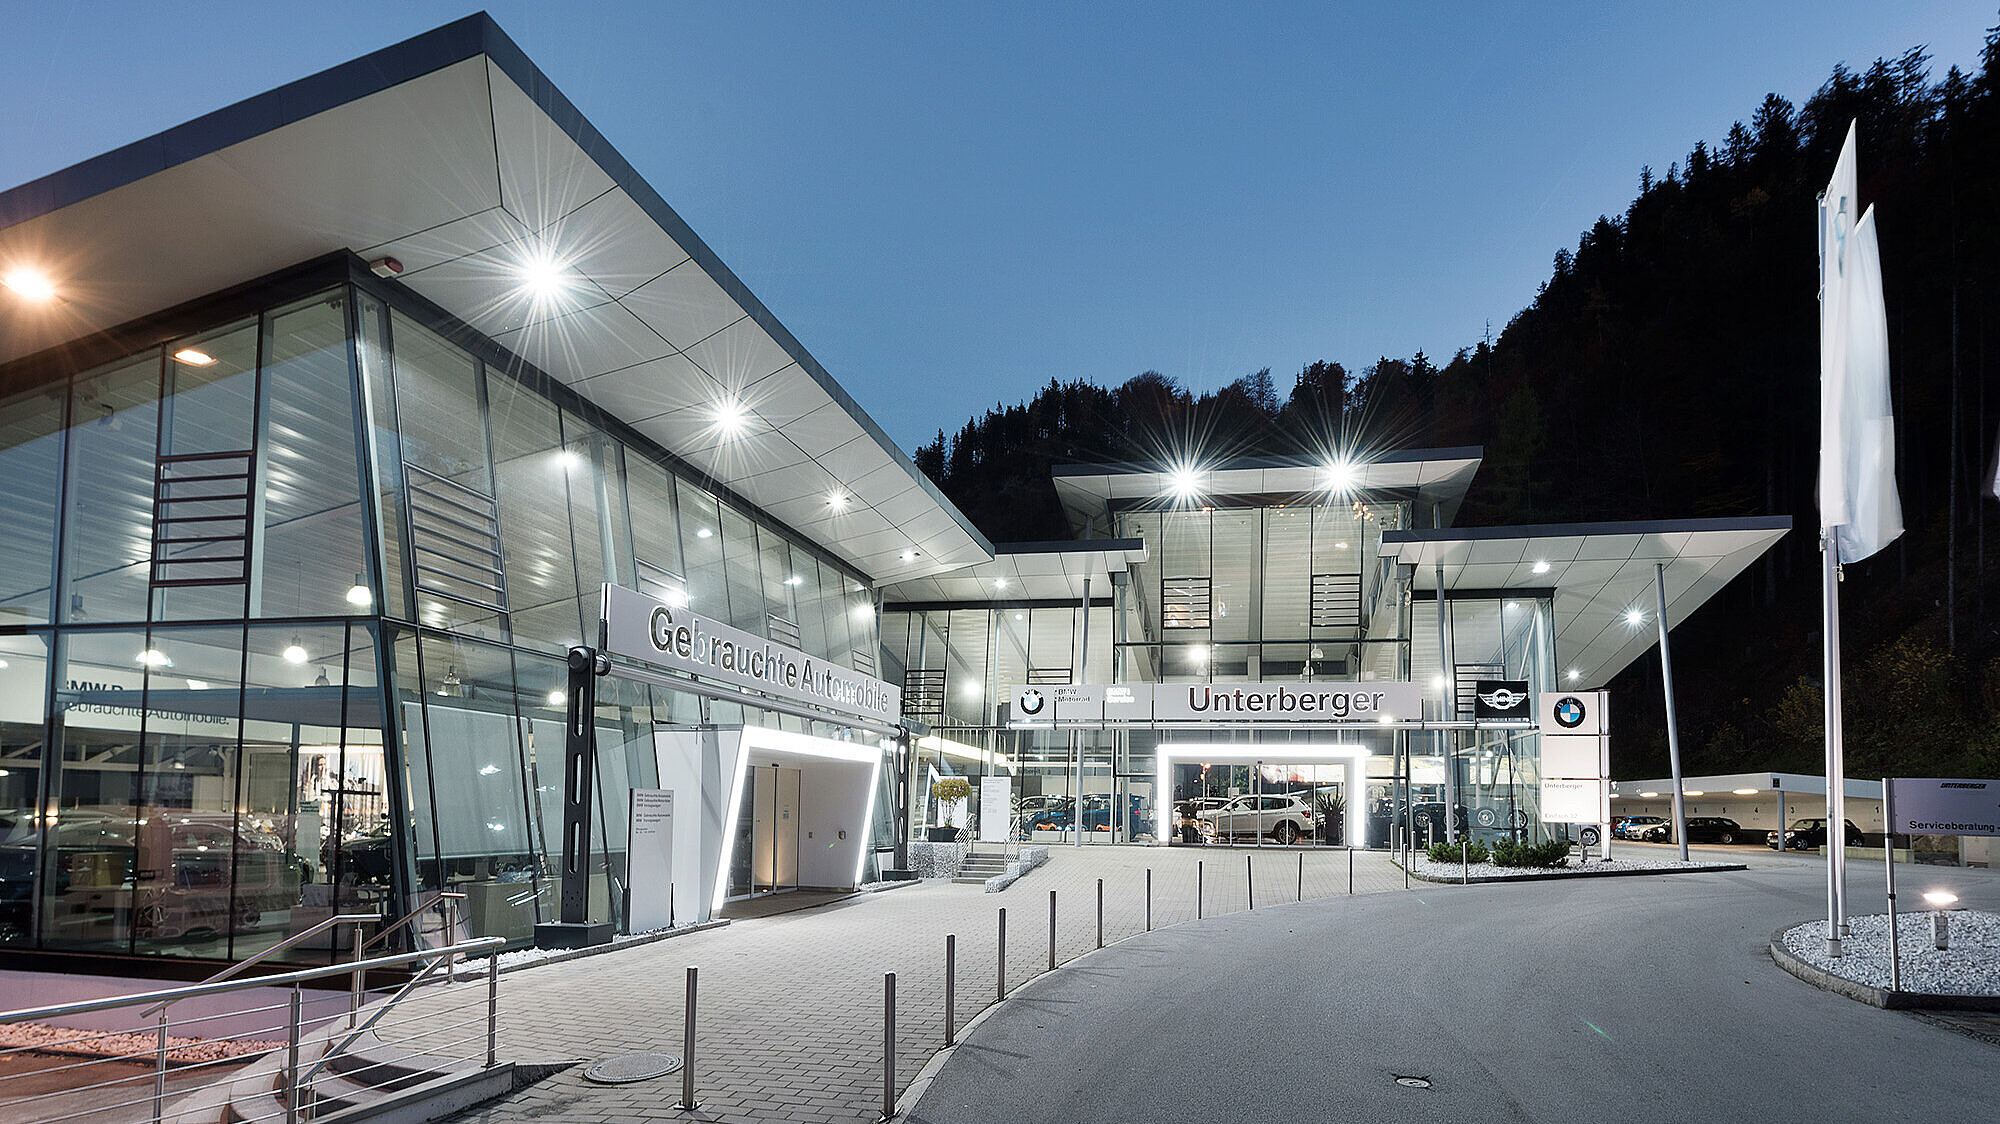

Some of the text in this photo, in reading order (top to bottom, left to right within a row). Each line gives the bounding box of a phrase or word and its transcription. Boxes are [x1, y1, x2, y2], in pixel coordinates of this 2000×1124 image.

[649, 605, 889, 713] Gebrauchte Automobile
[69, 702, 143, 716] ebrauchte
[1188, 686, 1385, 718] Unterberger
[1909, 820, 1995, 833] Serviceberatung
